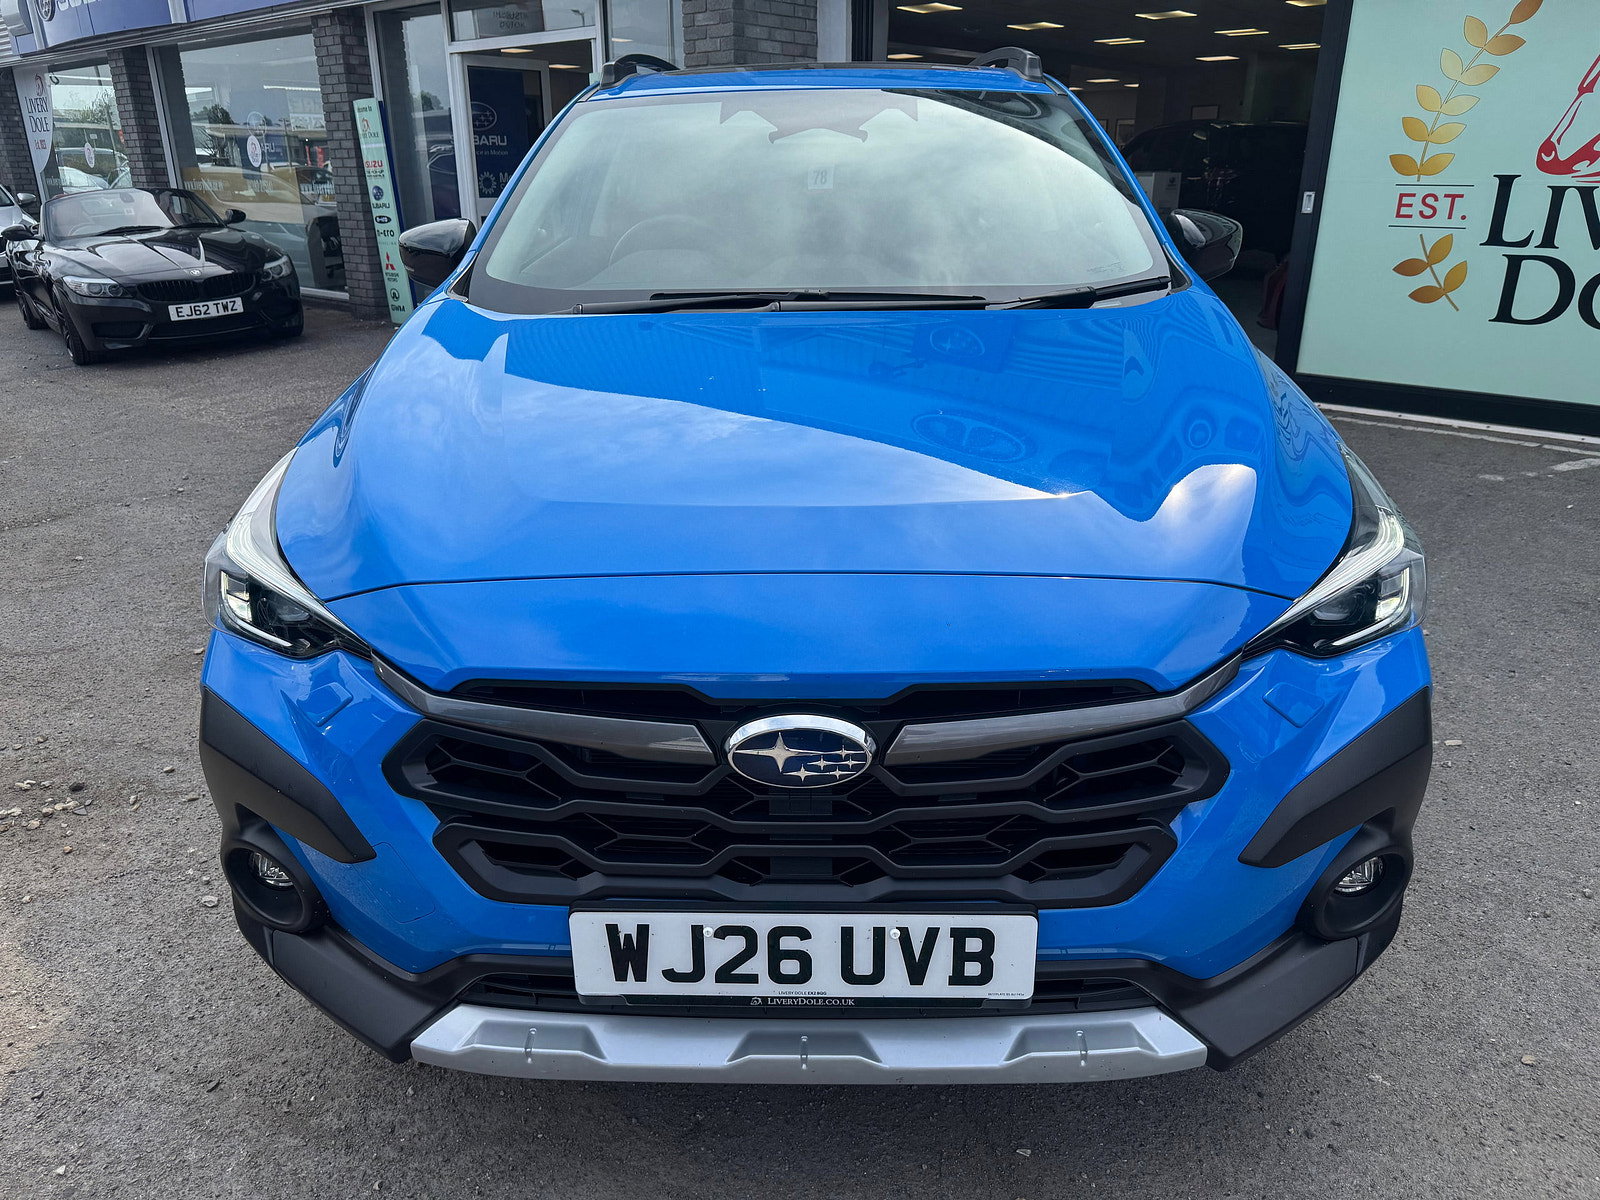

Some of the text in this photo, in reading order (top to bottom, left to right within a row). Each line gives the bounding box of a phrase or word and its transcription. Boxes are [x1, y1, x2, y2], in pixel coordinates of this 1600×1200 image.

[25, 96, 48, 113] LIVERY
[29, 115, 50, 132] DOLE
[473, 134, 507, 146] BARU
[813, 169, 827, 185] 78
[1394, 192, 1467, 221] EST.
[175, 300, 238, 318] EJ62 TWZ
[604, 923, 997, 987] WJ26 UVB
